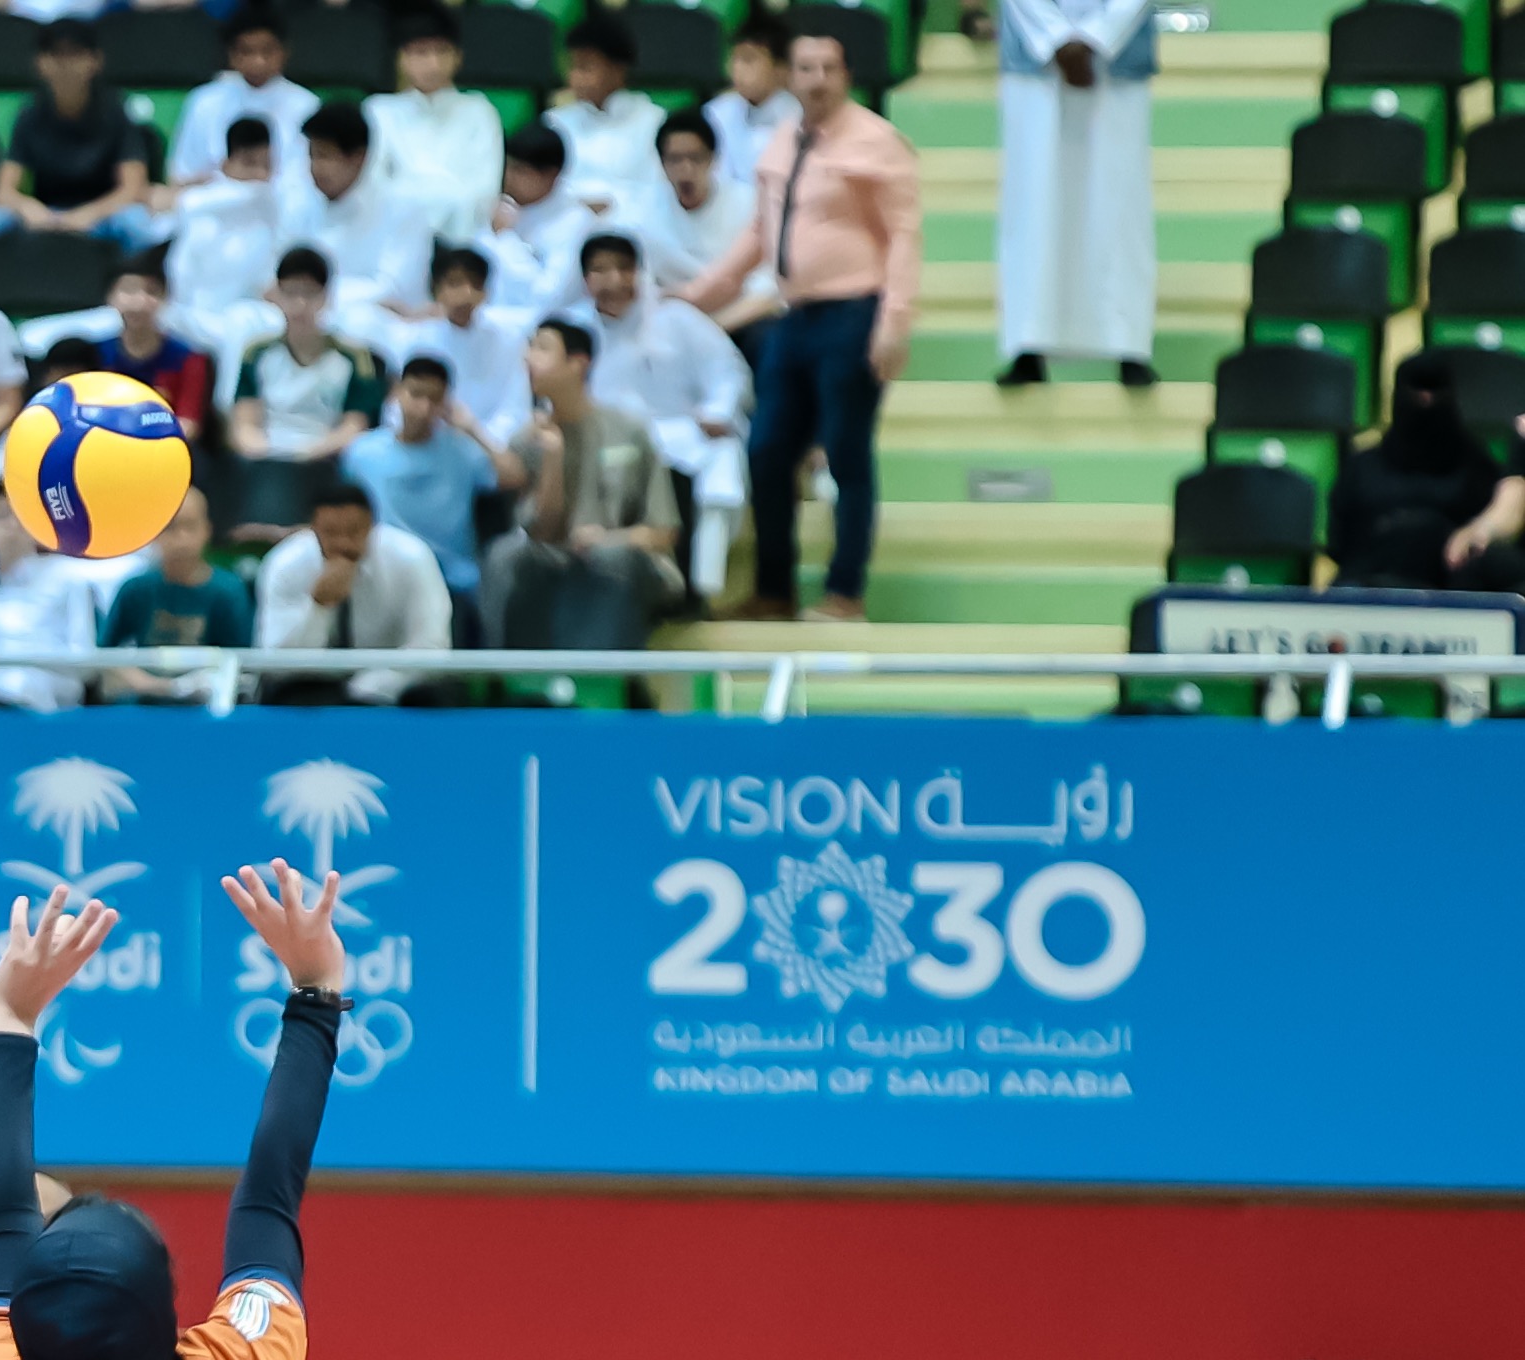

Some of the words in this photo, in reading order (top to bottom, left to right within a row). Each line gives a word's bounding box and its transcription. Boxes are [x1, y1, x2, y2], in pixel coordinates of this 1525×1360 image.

[654, 774, 901, 838] VISION
[235, 934, 413, 995] Sdi
[653, 1064, 818, 1095] KINGDOM
[828, 1066, 873, 1095] OF
[886, 1067, 990, 1097] SAUDI
[1000, 1069, 1133, 1098] ARABIA
